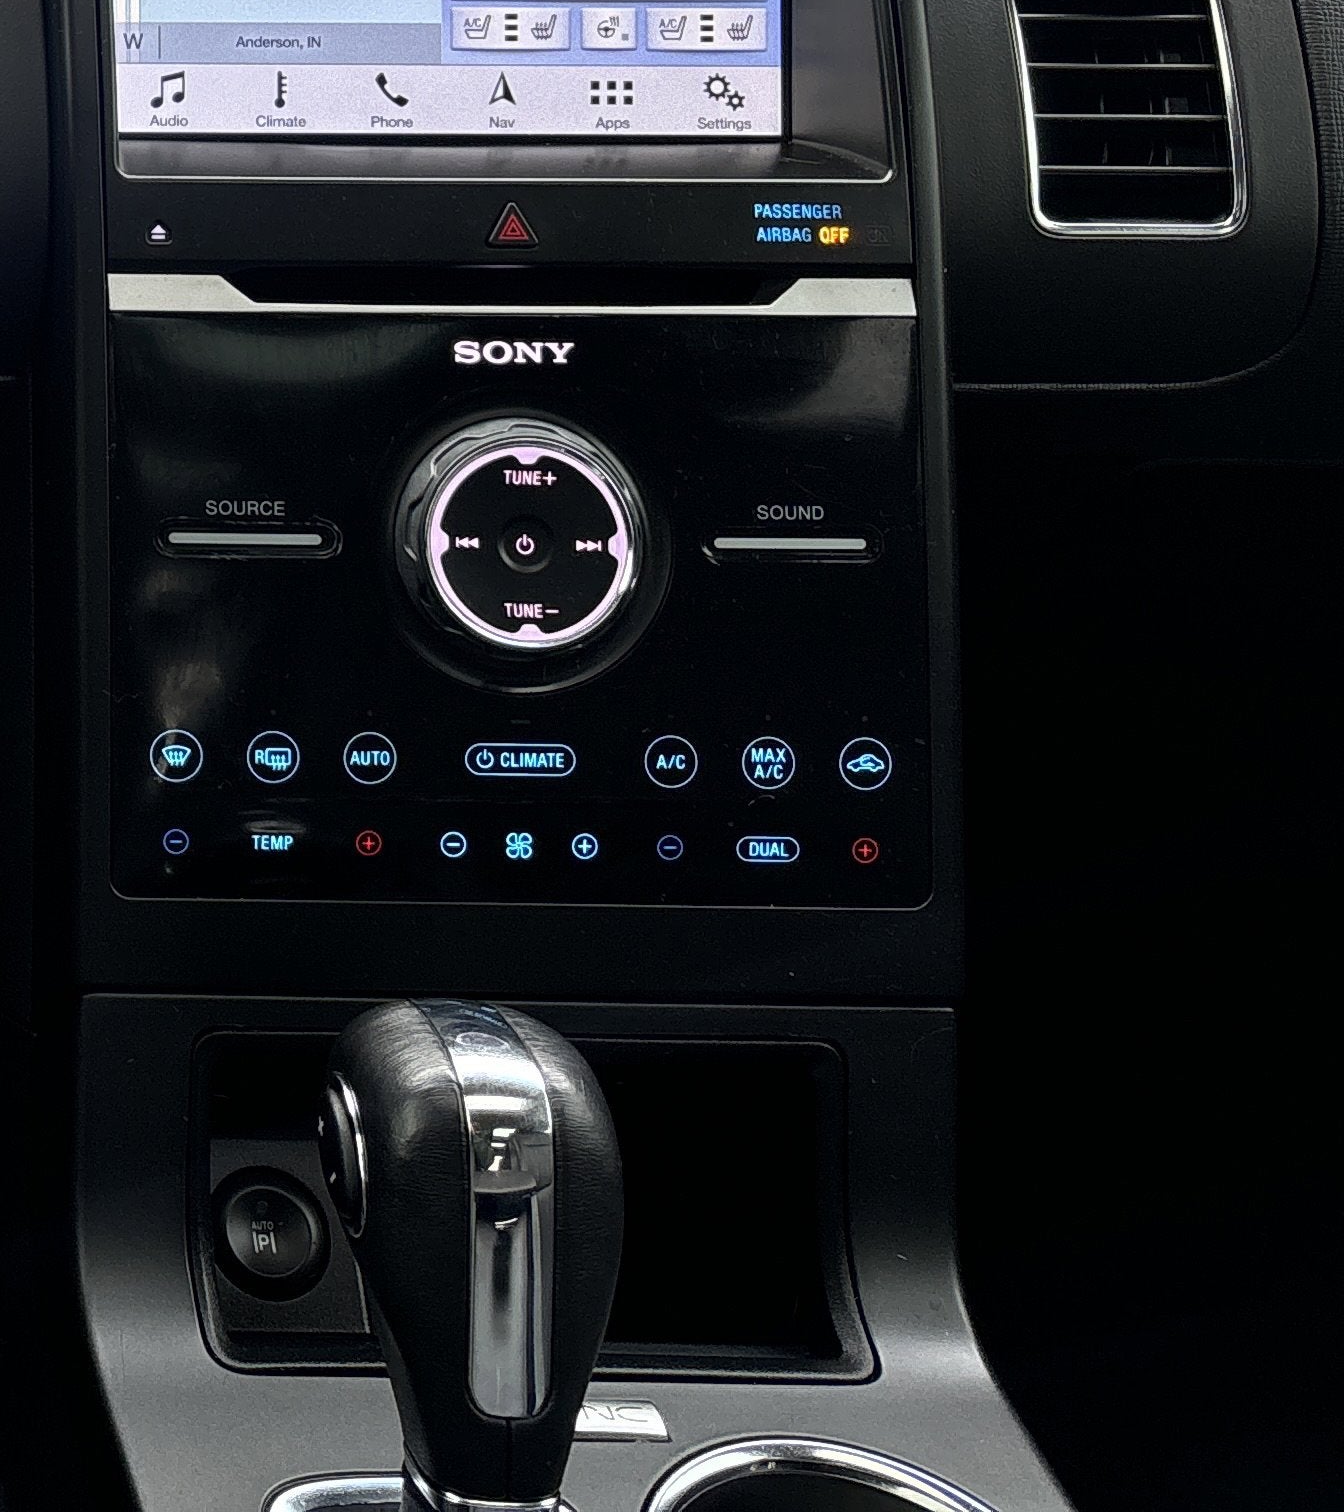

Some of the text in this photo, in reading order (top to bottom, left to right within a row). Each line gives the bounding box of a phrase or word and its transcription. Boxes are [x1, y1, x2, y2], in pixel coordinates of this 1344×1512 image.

[464, 17, 481, 30] A/C
[659, 18, 677, 30] A/C
[122, 33, 143, 49] W
[236, 35, 321, 49] Anderson, IN
[149, 115, 188, 126] Audio
[256, 115, 306, 127] Climate
[371, 116, 413, 127] Phone
[490, 117, 515, 128] Nav
[596, 118, 629, 130] Apps
[698, 118, 751, 131] Settings
[754, 204, 841, 219] PASSENGER
[757, 227, 849, 244] AIRBAG OFF
[454, 341, 574, 364] SONY
[206, 500, 285, 515] SOURCE
[757, 505, 824, 520] SOUND
[350, 751, 390, 766] AUTO
[501, 752, 564, 768] CLIMATE
[656, 755, 685, 769] A/C
[750, 747, 787, 763] MAX
[752, 762, 784, 779] A/C
[252, 835, 293, 850] TEMP
[748, 842, 789, 858] DUAL
[251, 1220, 275, 1231] AUTO
